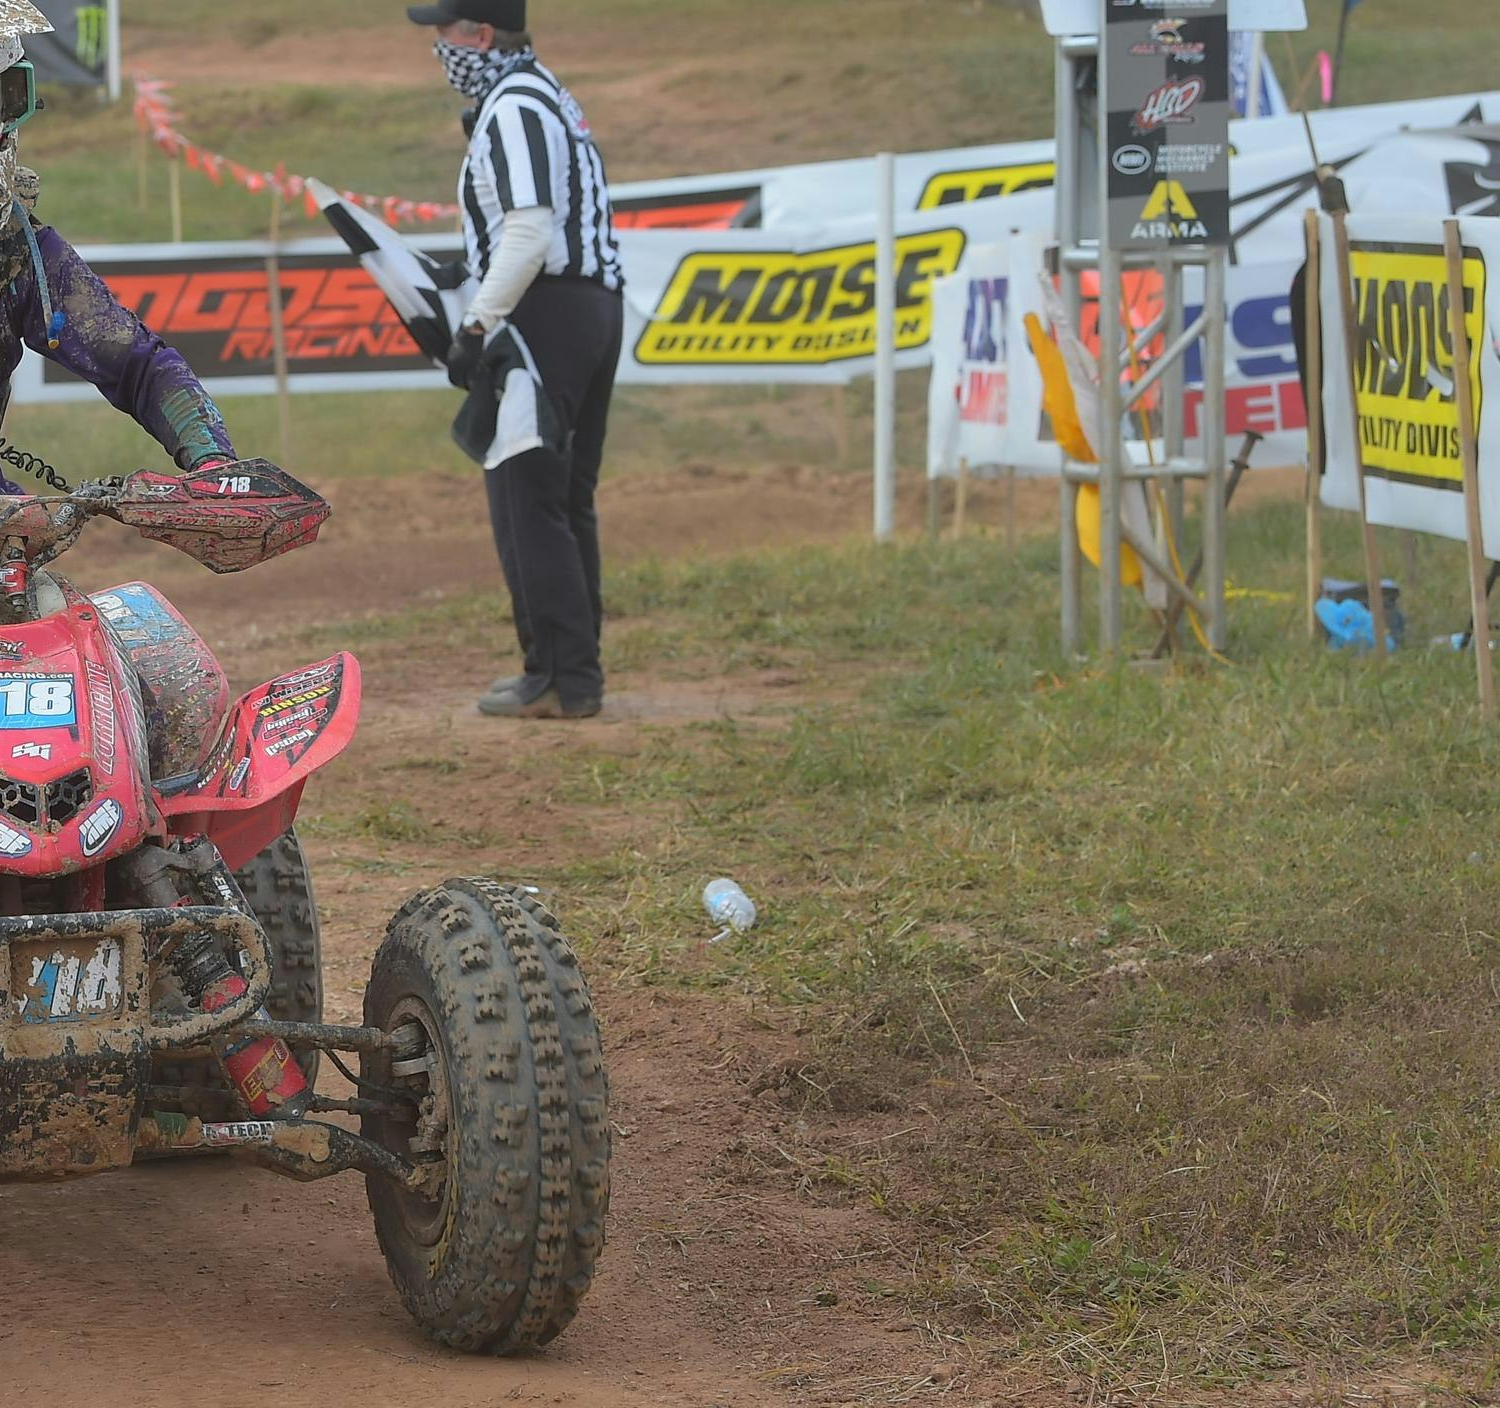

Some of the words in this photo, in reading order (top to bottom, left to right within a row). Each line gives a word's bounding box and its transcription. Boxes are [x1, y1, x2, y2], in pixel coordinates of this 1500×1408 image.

[1131, 221, 1208, 239] ARMA
[98, 267, 397, 333] MOOS
[220, 325, 423, 362] RACING
[654, 334, 784, 352] UTILITY
[1407, 422, 1461, 459] DIVIS
[218, 476, 251, 494] 718
[85, 660, 114, 775] HURRICANE
[259, 686, 331, 718] HINSON
